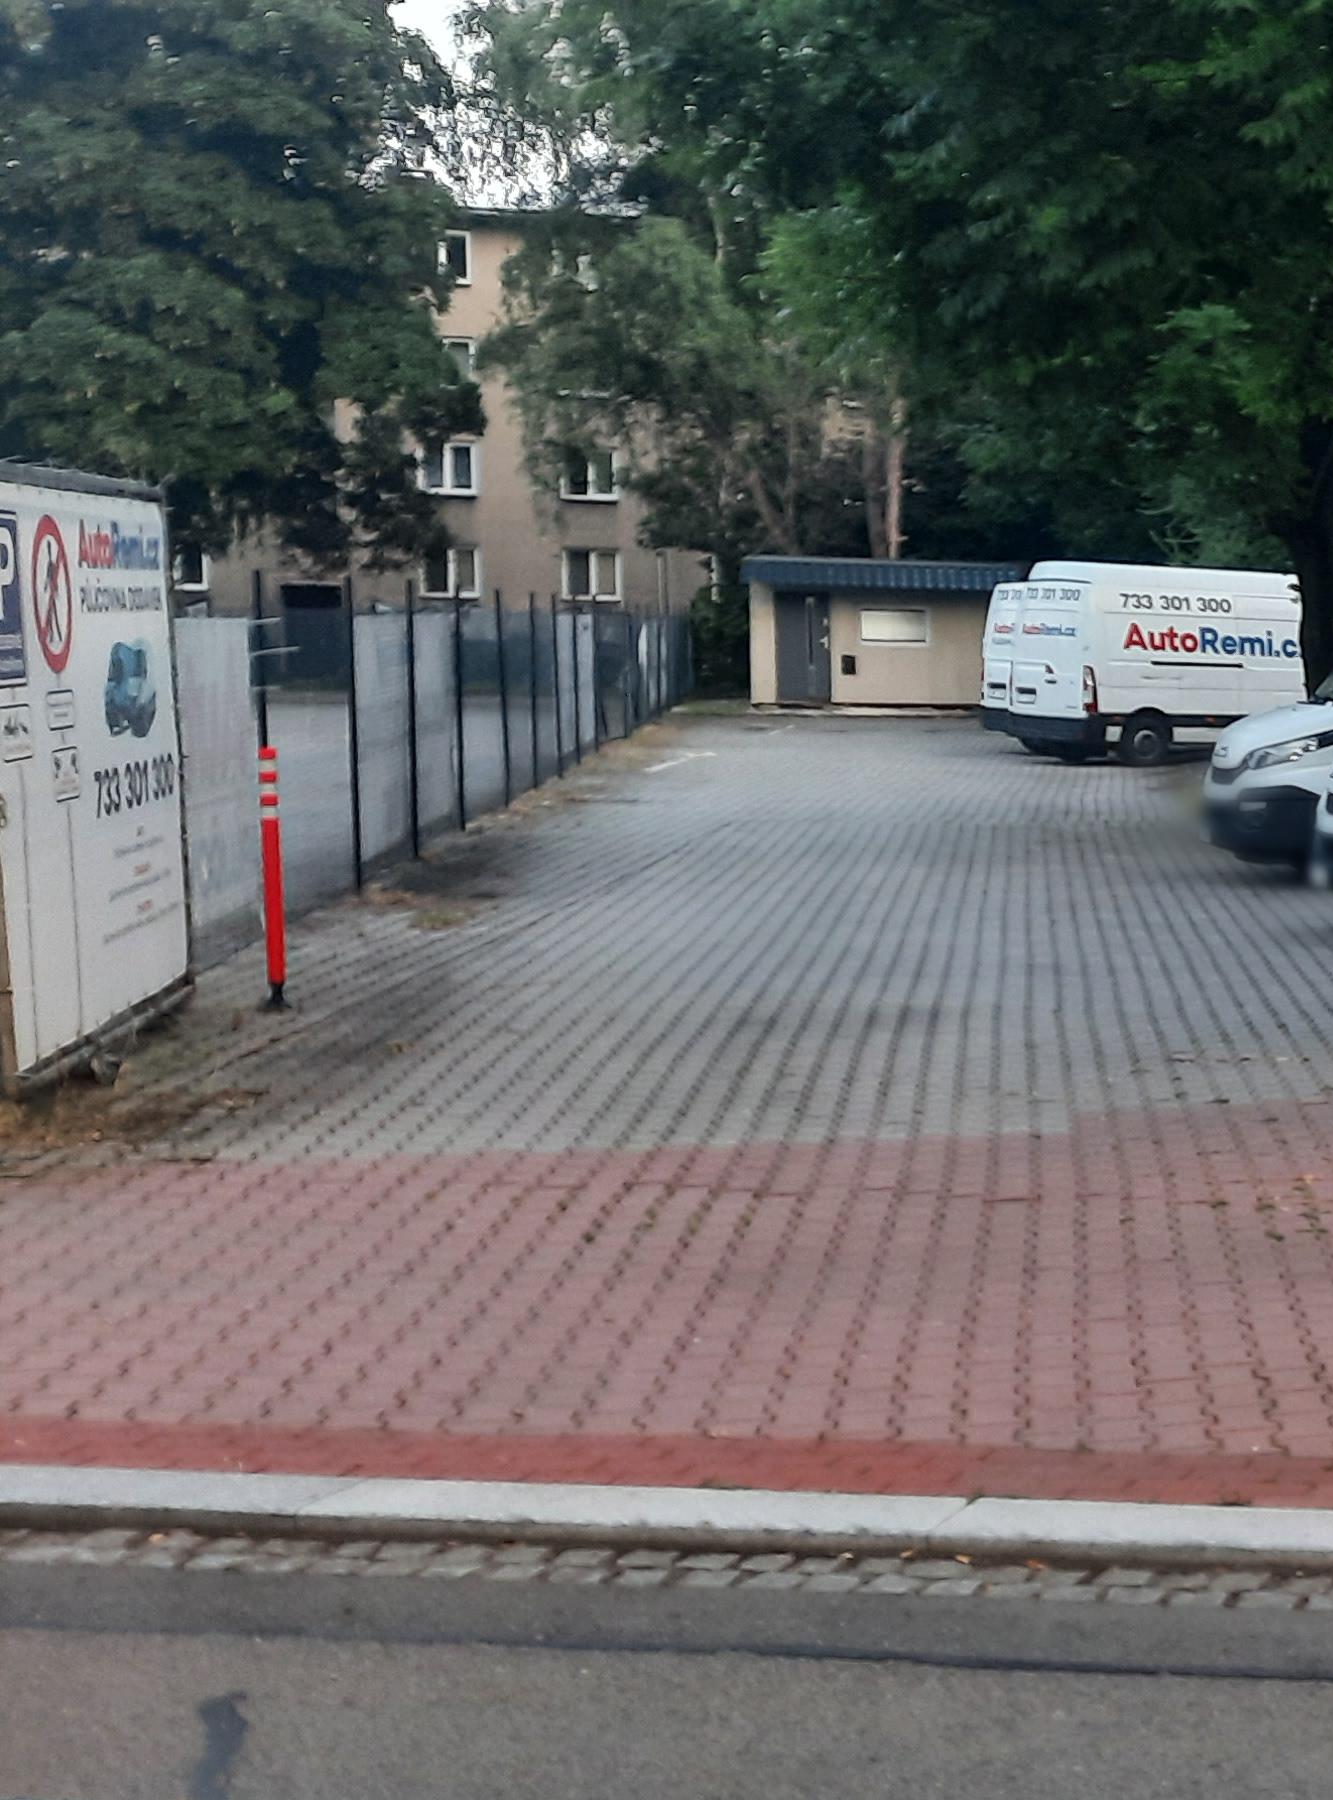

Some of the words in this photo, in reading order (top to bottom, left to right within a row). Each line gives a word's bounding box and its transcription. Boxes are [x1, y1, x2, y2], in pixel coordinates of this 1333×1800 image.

[1120, 593, 1153, 609] 733
[1160, 595, 1191, 611] 301
[1197, 597, 1232, 613] 300
[1123, 622, 1299, 658] AutoRemi.c
[94, 767, 120, 818] 733
[125, 760, 148, 808] 301
